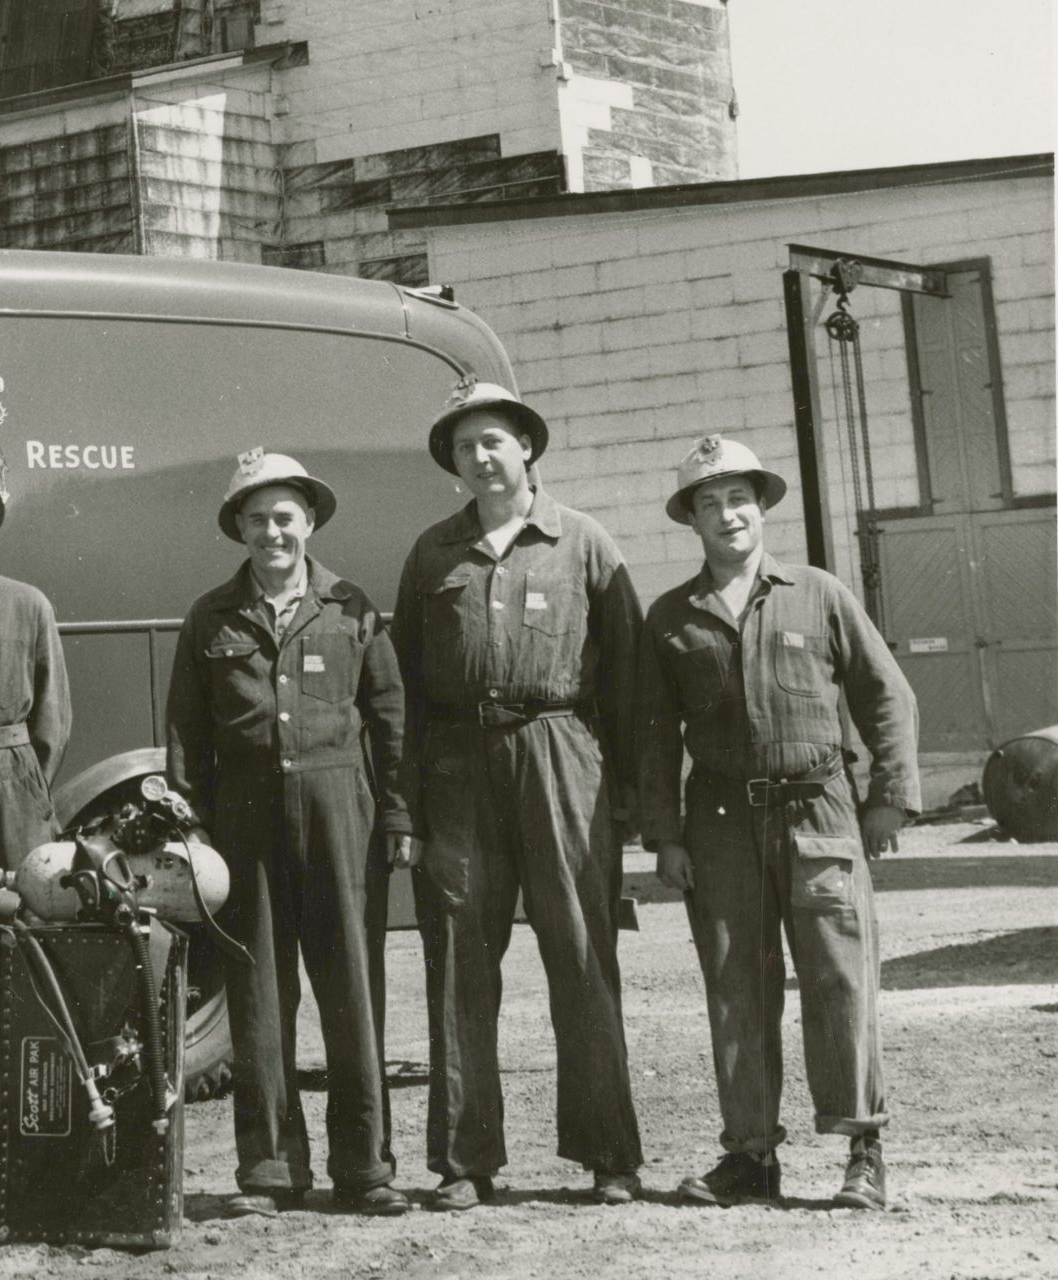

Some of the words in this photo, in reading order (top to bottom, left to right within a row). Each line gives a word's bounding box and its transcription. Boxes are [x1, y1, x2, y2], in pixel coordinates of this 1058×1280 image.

[25, 440, 136, 470] RESCUE
[29, 1040, 40, 1063] PAK
[29, 1068, 39, 1087] AIR
[23, 1087, 39, 1132] Scott
